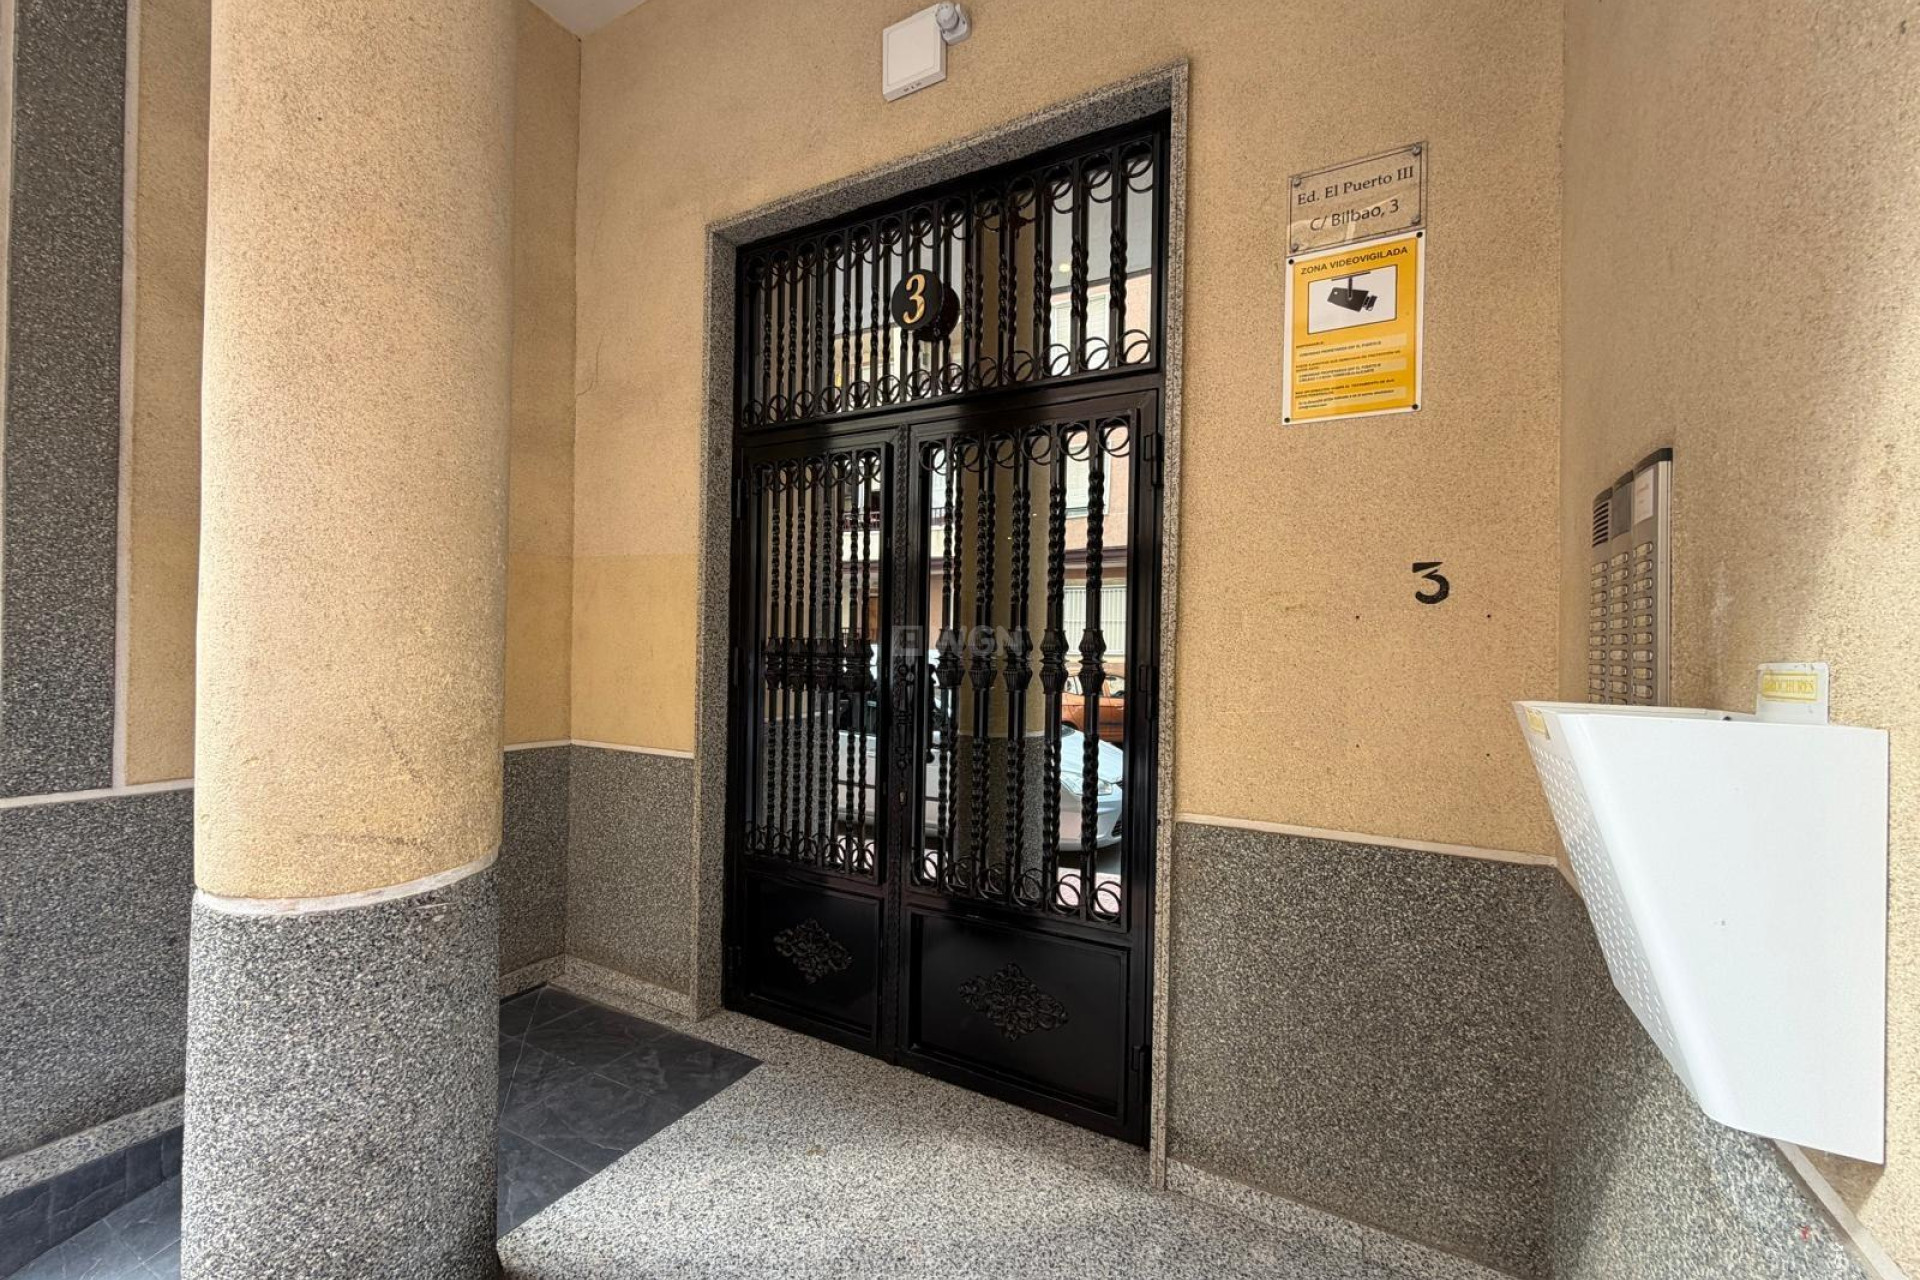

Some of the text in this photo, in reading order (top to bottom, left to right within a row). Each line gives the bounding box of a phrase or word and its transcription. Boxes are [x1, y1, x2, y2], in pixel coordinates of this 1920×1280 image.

[1297, 166, 1414, 205] Ed. El Puerto III
[1310, 199, 1399, 231] C/ Bilbao, 3
[1300, 246, 1408, 275] ZONA VIDEOVIGILADA
[903, 273, 925, 324] 3
[1412, 561, 1450, 604] 3
